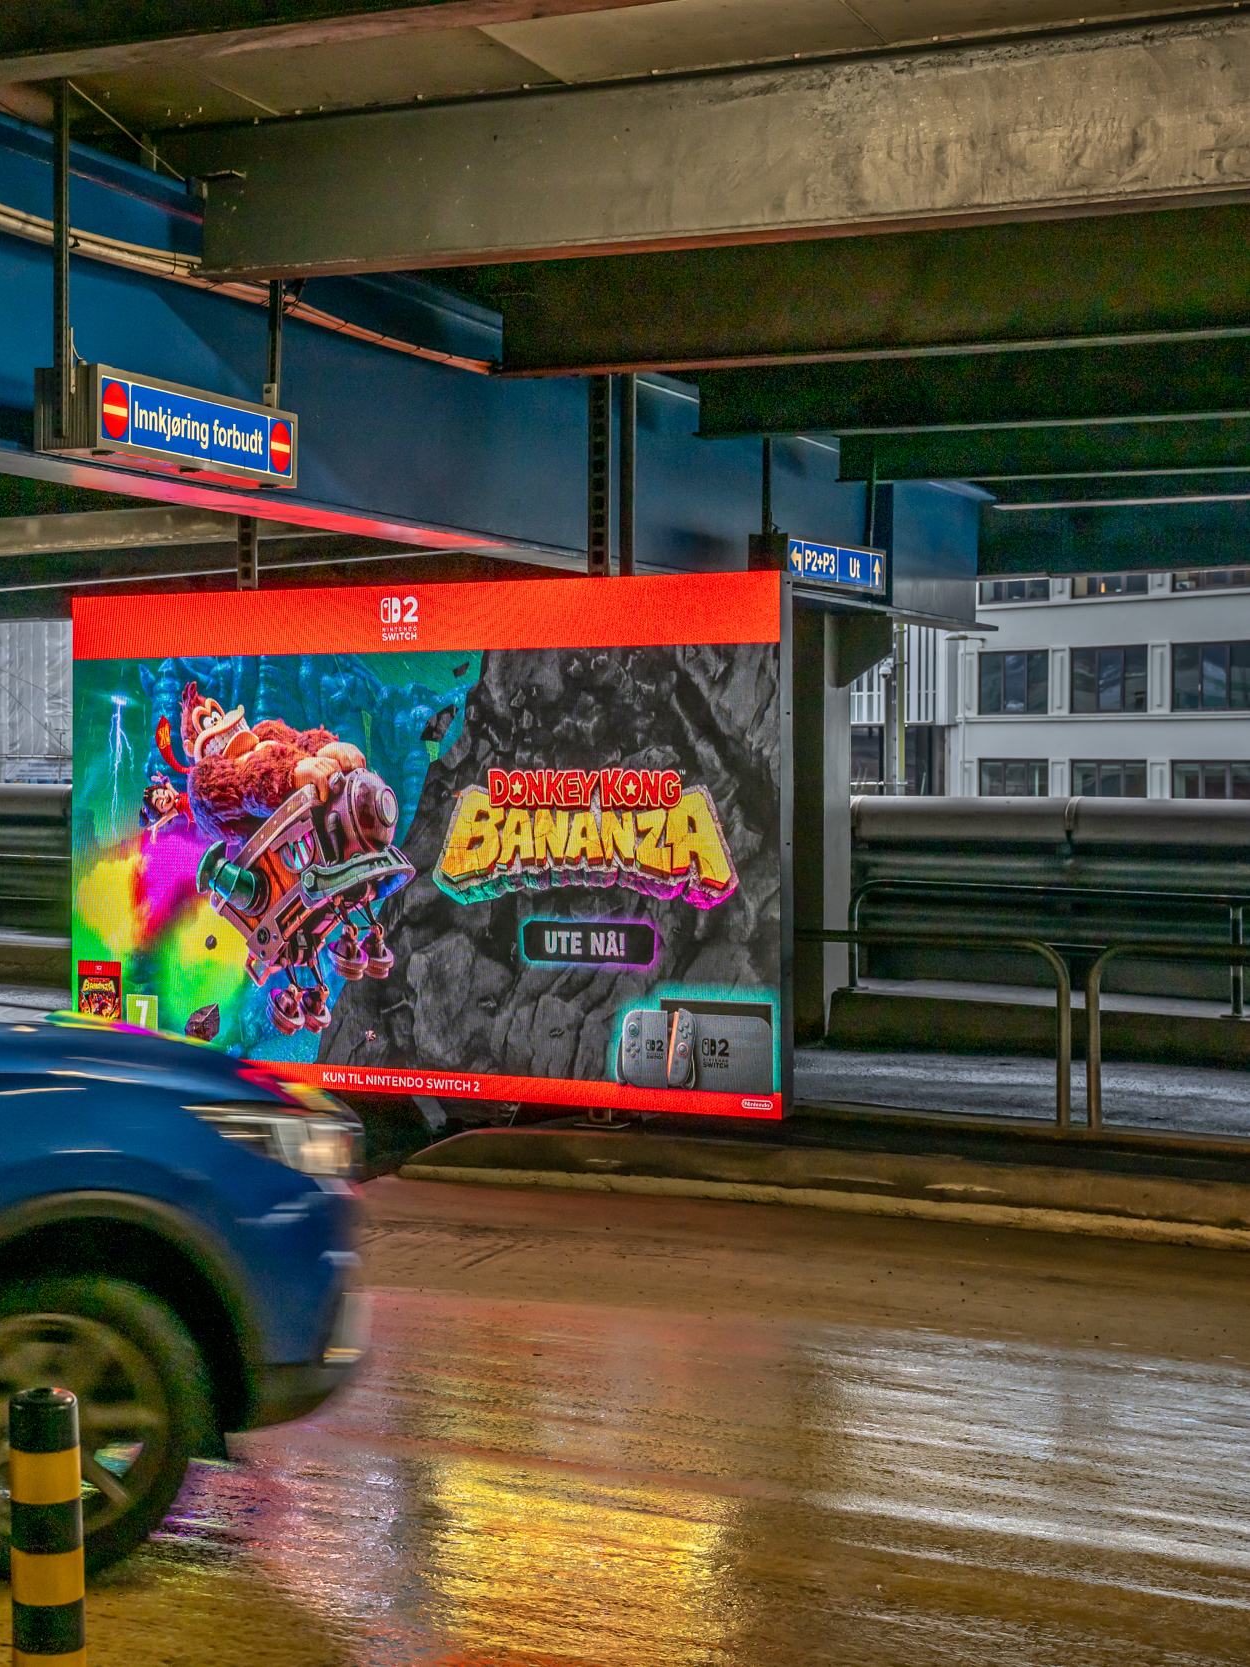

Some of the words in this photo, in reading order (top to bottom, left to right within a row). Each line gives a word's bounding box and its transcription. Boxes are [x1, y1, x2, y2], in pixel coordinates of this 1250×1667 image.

[134, 401, 210, 450] Innkjøring
[213, 419, 264, 455] forbudt
[804, 549, 836, 575] P2+P3
[849, 557, 861, 579] Ut
[382, 632, 418, 642] SWITCH
[487, 768, 600, 809] DONKEY
[599, 767, 682, 809] KONG
[440, 789, 733, 891] BANANZA
[544, 930, 582, 955] UTE
[590, 930, 626, 957] NÅ!
[135, 1000, 149, 1028] 7
[322, 1071, 346, 1084] KUN
[348, 1073, 364, 1085] TIL
[365, 1074, 424, 1089] NINTENDO
[426, 1078, 471, 1092] SWITCH
[473, 1081, 480, 1092] 2
